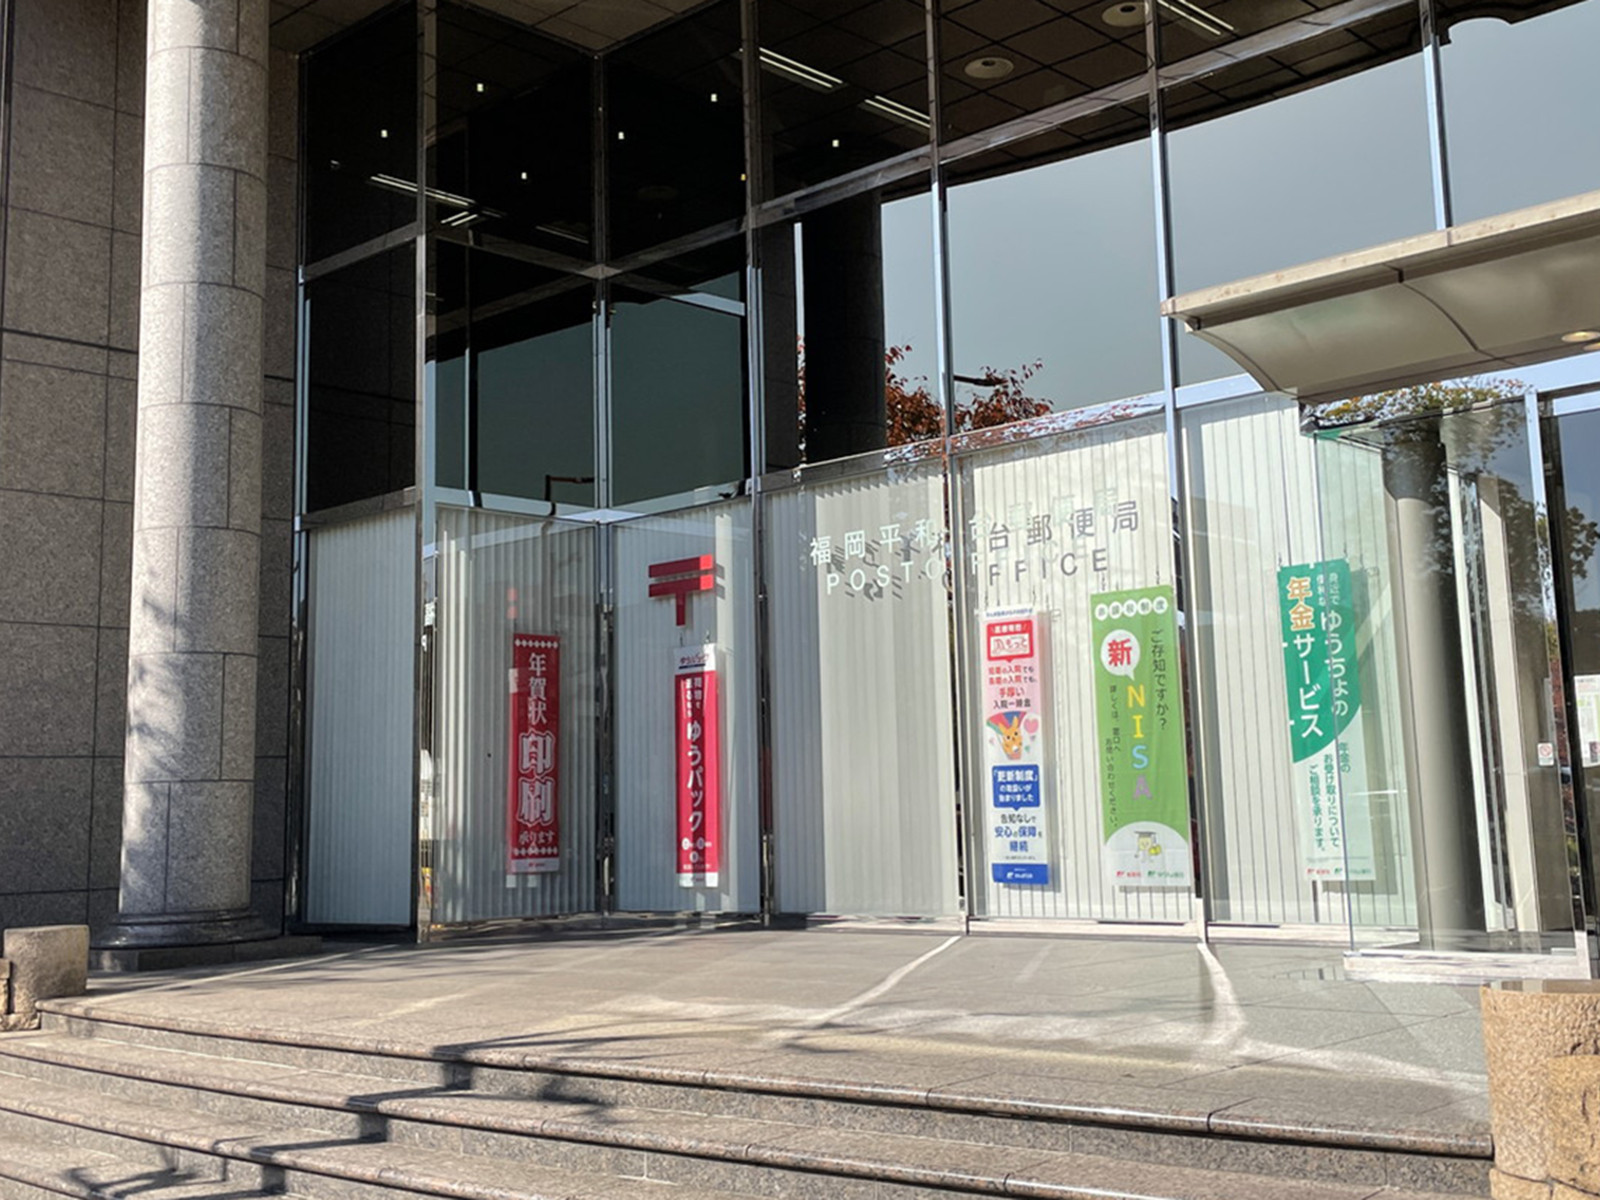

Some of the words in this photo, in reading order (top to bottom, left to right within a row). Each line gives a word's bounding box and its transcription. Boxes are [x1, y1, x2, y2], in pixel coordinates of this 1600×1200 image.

[1107, 638, 1133, 667] 新
[1286, 576, 1324, 738] 年金サービス
[1320, 609, 1349, 716] ゆうちょの
[686, 720, 703, 831] ゆうパック
[1126, 683, 1154, 801] NISA
